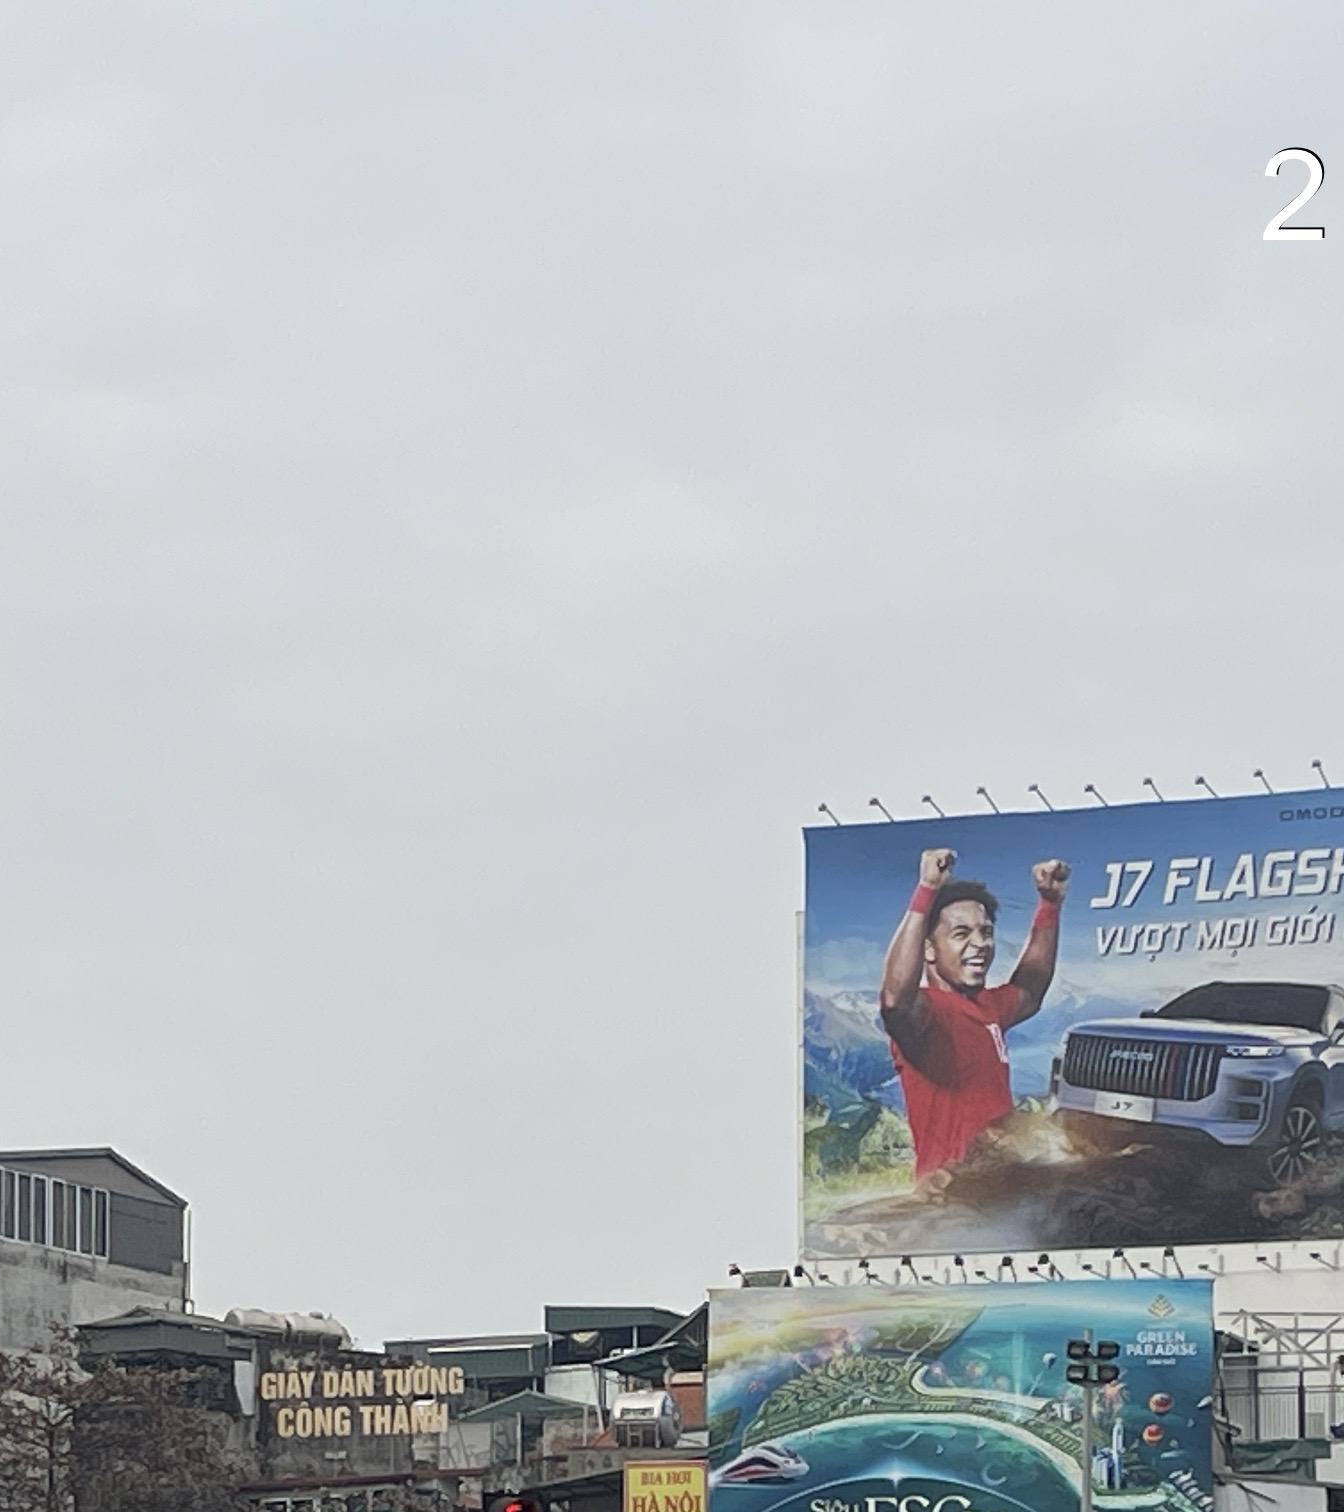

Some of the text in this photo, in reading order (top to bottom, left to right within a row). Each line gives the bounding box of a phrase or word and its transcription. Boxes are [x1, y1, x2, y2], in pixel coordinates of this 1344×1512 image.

[1090, 859, 1154, 910] J7
[1095, 919, 1191, 963] VƯỢT
[1195, 918, 1259, 960] MỌI
[1265, 905, 1335, 947] GIỚI
[1125, 1343, 1198, 1356] PARADISE
[1136, 1331, 1186, 1344] GREEN
[260, 1362, 316, 1401] GIẤY
[381, 1360, 465, 1397] TƯỜNG
[276, 1402, 353, 1438] CÔNG
